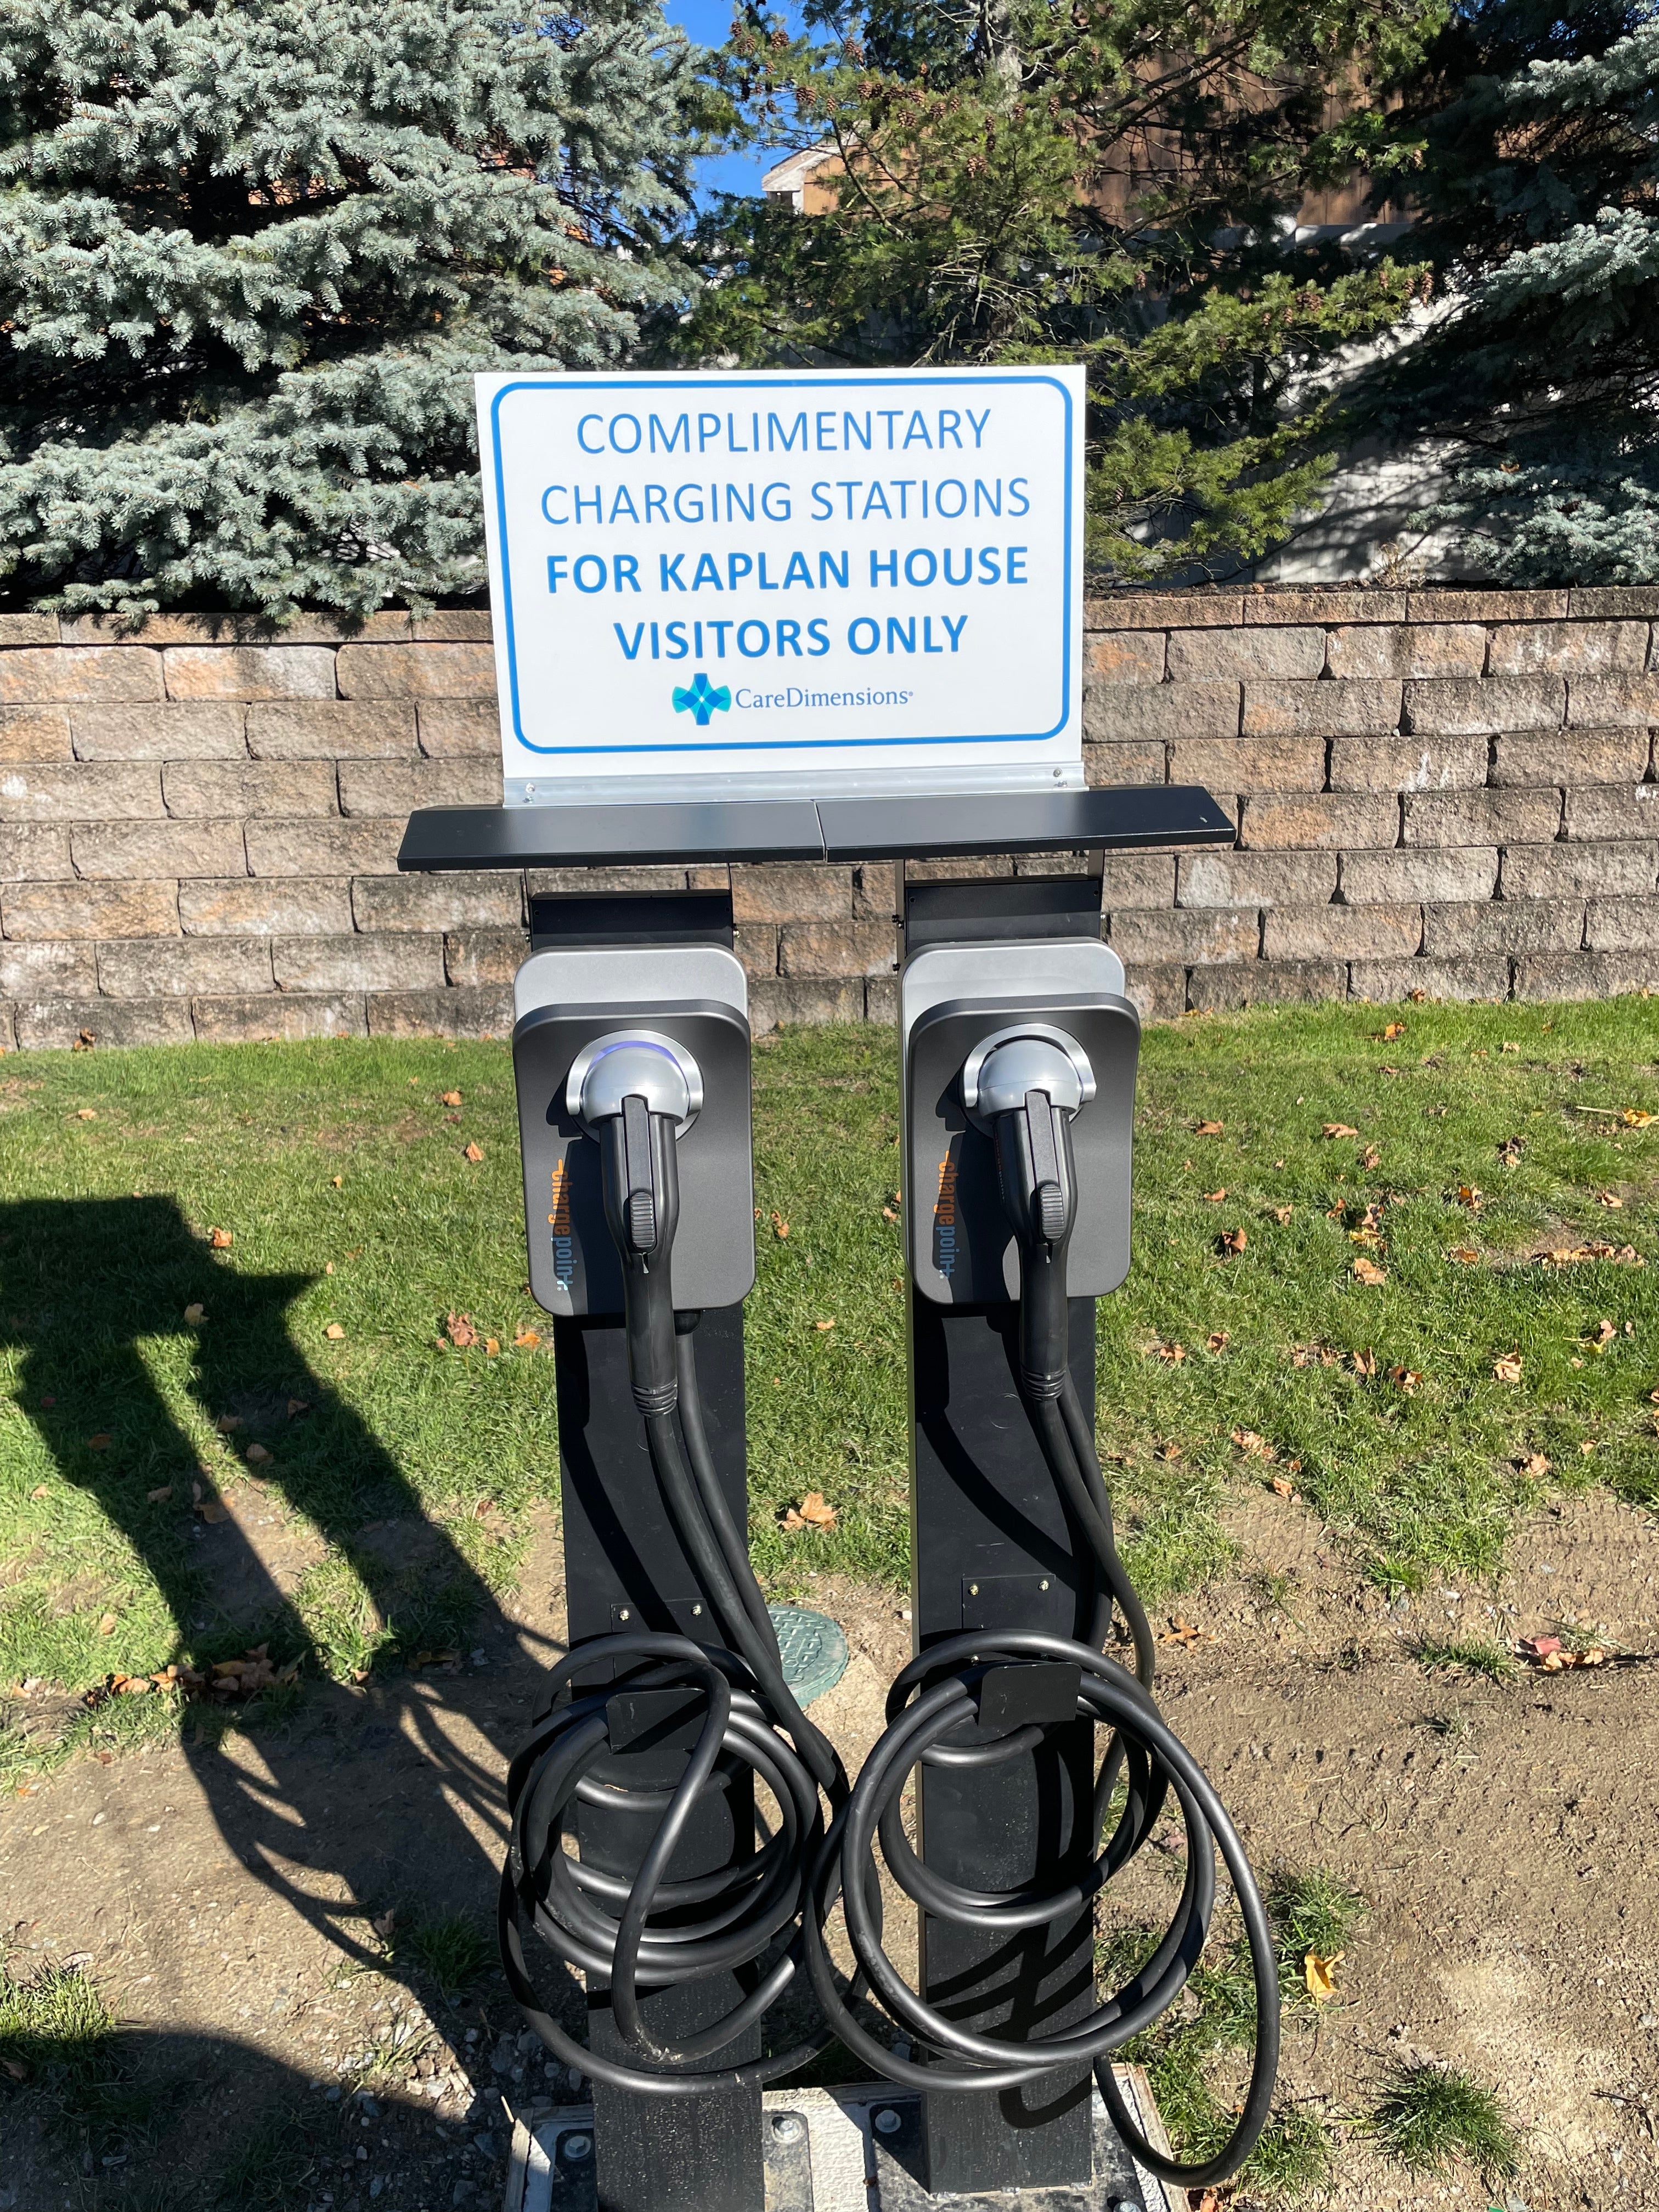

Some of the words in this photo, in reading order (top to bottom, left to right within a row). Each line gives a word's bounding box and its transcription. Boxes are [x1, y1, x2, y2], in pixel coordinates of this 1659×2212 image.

[578, 409, 990, 454] COMPLIMENTARY
[541, 482, 791, 524] CHARGING
[811, 478, 1029, 521] STATIONS
[547, 554, 641, 594] FOR
[660, 551, 849, 591] KAPLAN
[870, 546, 1027, 588] HOUSE
[614, 618, 830, 659] VISITORS
[848, 615, 968, 655] ONLY
